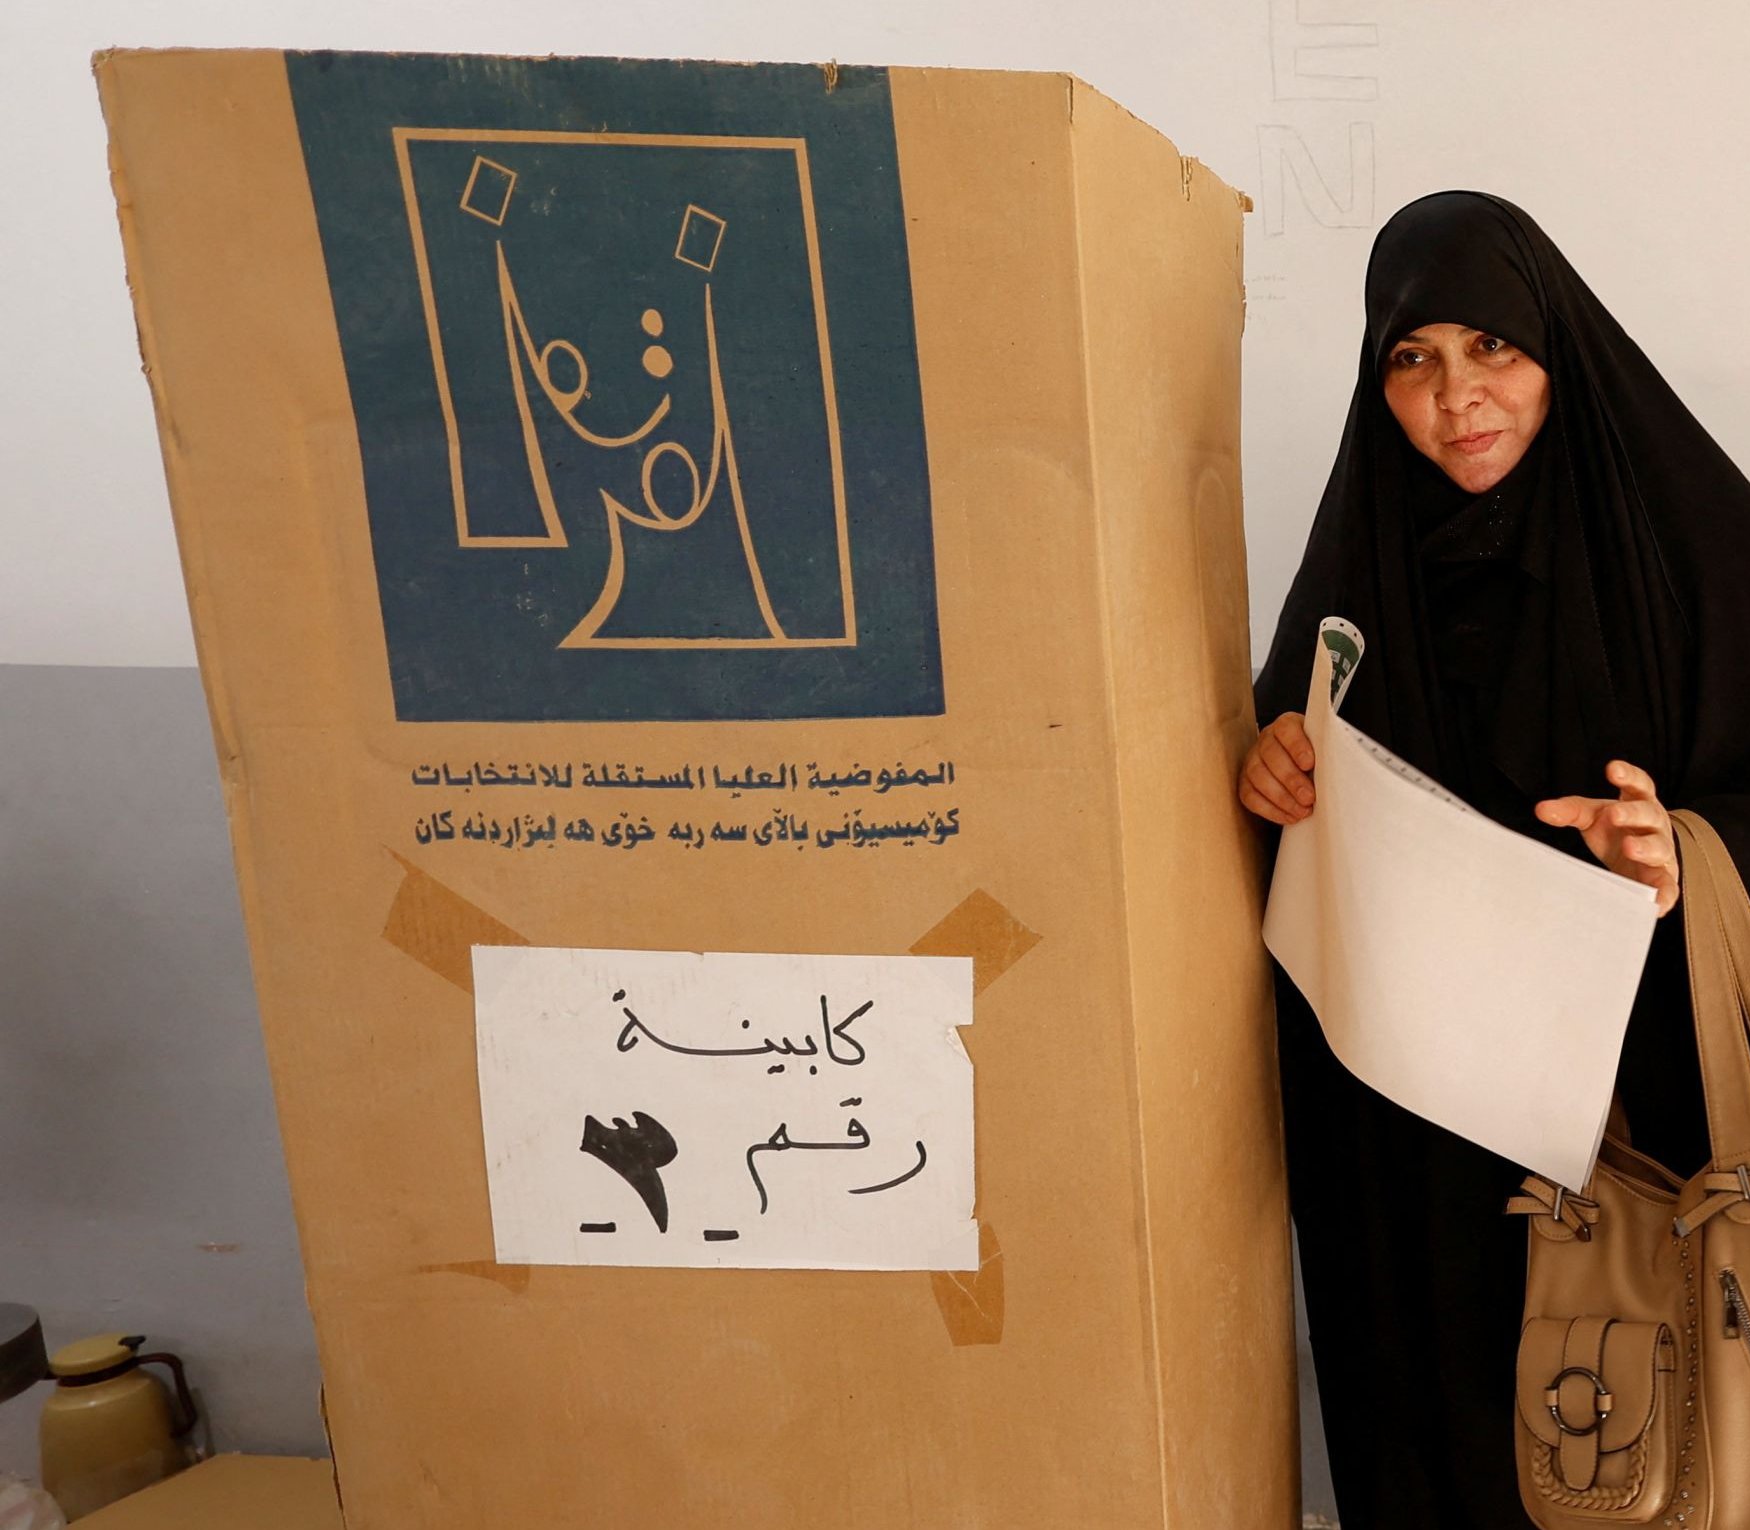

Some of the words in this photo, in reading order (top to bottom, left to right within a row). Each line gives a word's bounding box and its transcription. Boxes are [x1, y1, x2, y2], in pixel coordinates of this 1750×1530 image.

[411, 761, 572, 793] للانتخابات
[582, 762, 705, 790] المستقلة
[712, 762, 798, 798] العليا
[806, 761, 955, 797] المفوضية
[613, 988, 874, 1077] كابينة
[746, 1097, 928, 1215] رقم
